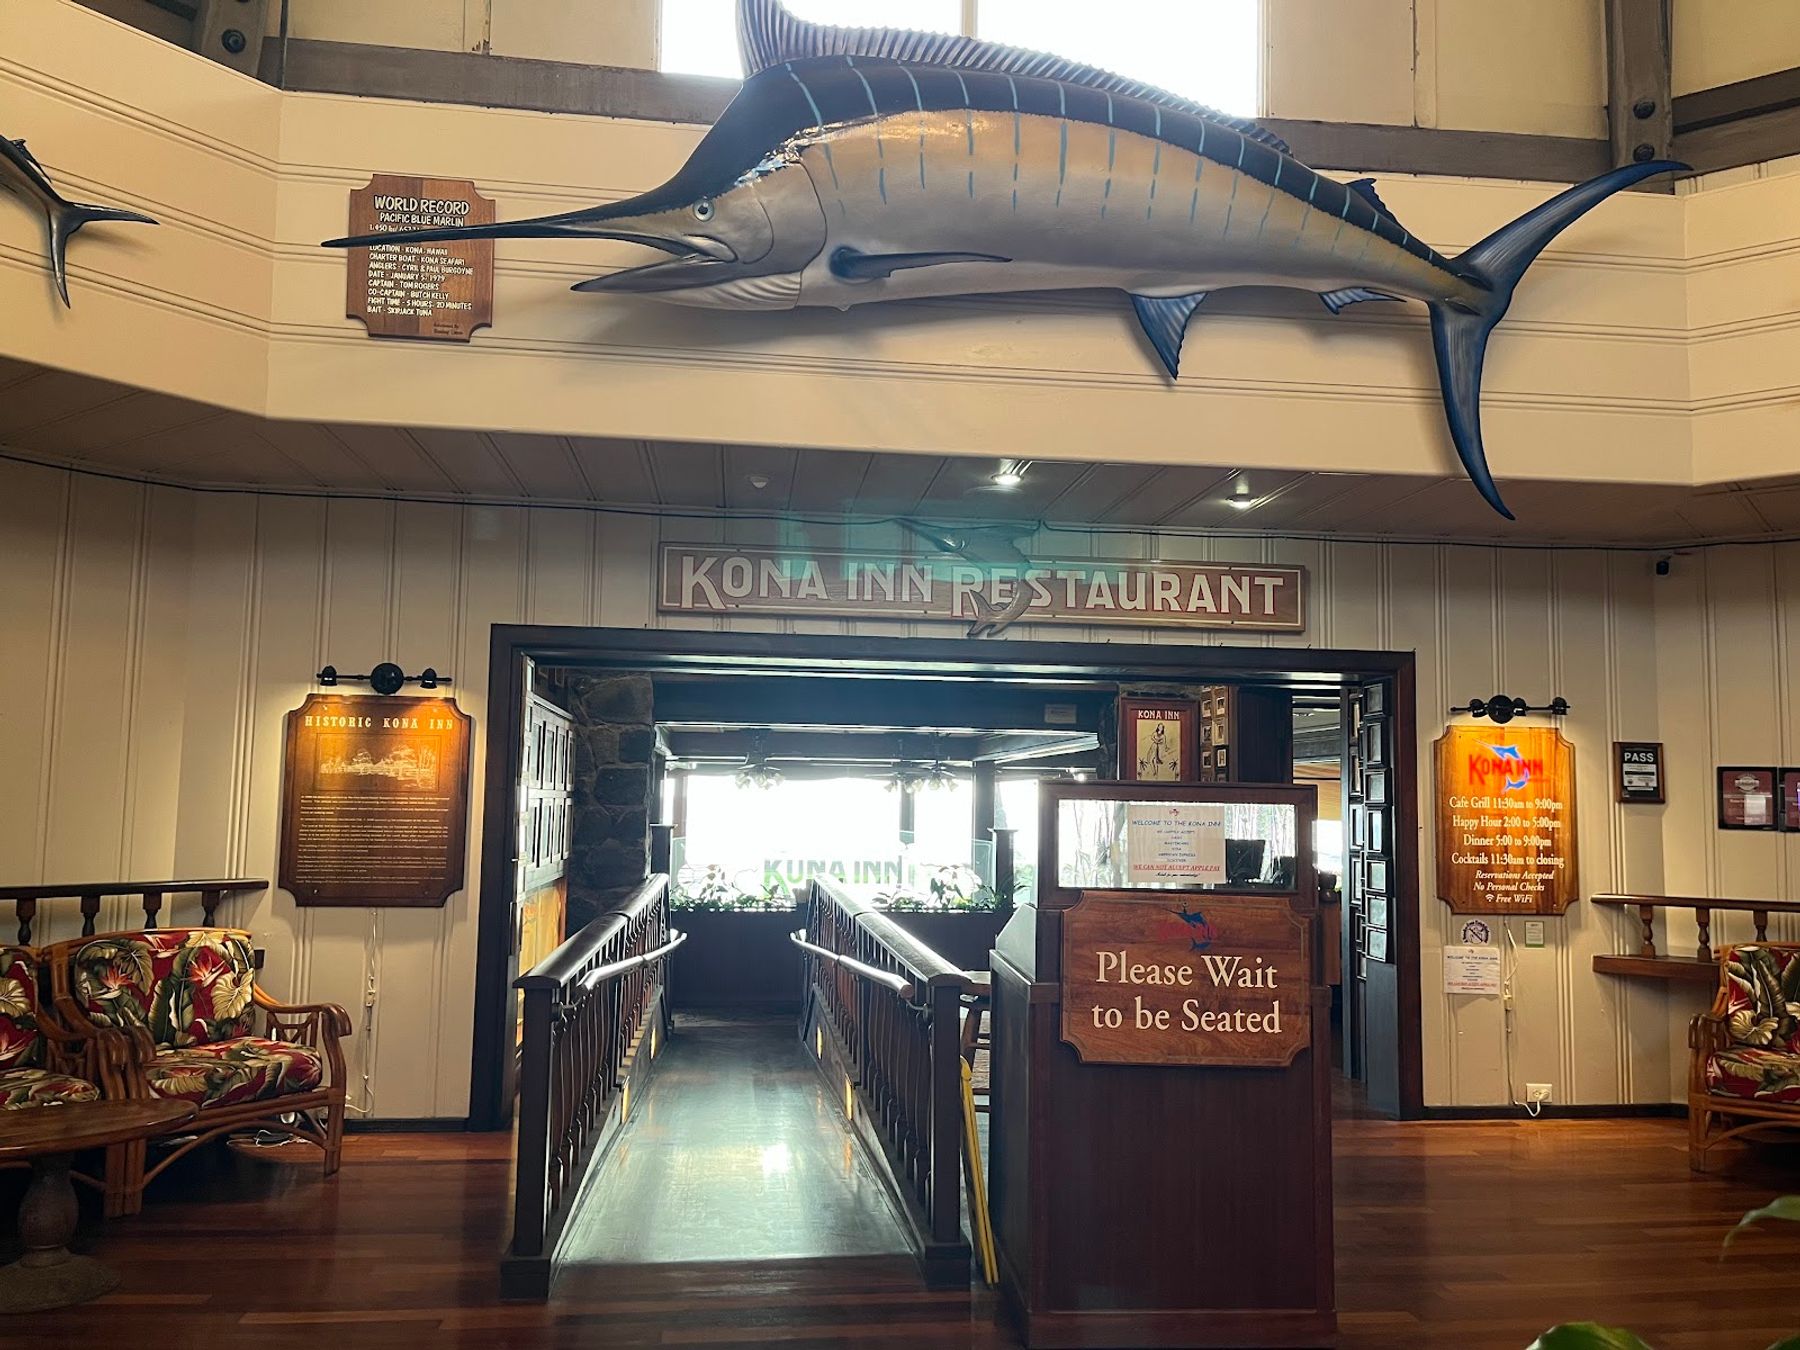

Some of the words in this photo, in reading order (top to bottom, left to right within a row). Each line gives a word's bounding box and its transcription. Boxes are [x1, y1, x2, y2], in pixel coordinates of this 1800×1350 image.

[374, 195, 418, 212] WORLD
[420, 199, 470, 215] RECORD
[380, 212, 410, 223] PACIFIC
[411, 214, 432, 225] BLUE
[433, 216, 464, 227] MARLIN
[369, 253, 398, 261] CHARTER
[398, 254, 416, 262] BOAT
[420, 256, 439, 264] KONA
[369, 261, 397, 270] ANGLERS
[368, 270, 385, 278] DATE
[390, 272, 420, 280] JANUARY
[368, 280, 394, 288] CAPTAIN
[399, 281, 414, 289] TOM
[414, 282, 440, 290] ROGERS
[368, 288, 406, 298] CO-CAPTAIN
[410, 290, 431, 299] BUTCH
[431, 292, 449, 300] KELLY
[367, 298, 385, 306] FIGHT
[386, 298, 400, 306] TIME
[436, 301, 445, 309] 20
[445, 302, 472, 310] MINUTES
[415, 308, 432, 316] TUNA
[681, 556, 837, 609] KONA
[846, 561, 934, 603] INN
[951, 565, 1286, 616] RESTAURANT
[1138, 710, 1161, 719] KONA
[1164, 711, 1179, 720] INN
[305, 715, 372, 727] HISTORIC
[383, 717, 419, 729] KONA
[429, 718, 453, 730] INN
[1624, 752, 1654, 763] PASS
[1469, 754, 1513, 785] KONA
[1516, 759, 1543, 776] INN
[1449, 796, 1469, 809] Cafe
[1470, 796, 1490, 809] Grill
[1493, 797, 1524, 809] 11:30am
[1525, 799, 1534, 809] to
[1534, 798, 1563, 813] 9:00pm
[1453, 815, 1479, 830] Happy
[1480, 815, 1502, 827] Hour
[1503, 816, 1521, 828] 2:00
[1522, 818, 1530, 828] to
[1532, 816, 1561, 831] 5:00pm
[1463, 834, 1494, 846] Dinner
[1495, 834, 1513, 847] 5:00
[1514, 837, 1522, 846] to
[1523, 835, 1552, 850] 9:00pm
[1451, 852, 1489, 865] Cocktails
[1490, 853, 1524, 865] 11:30am
[1526, 855, 1535, 865] to
[1536, 853, 1564, 869] closing
[854, 861, 902, 884] INN
[1475, 869, 1521, 880] Reservations
[1521, 870, 1555, 882] Accepted
[1473, 882, 1485, 891] No
[1486, 882, 1518, 891] Personal
[1519, 882, 1545, 891] Checks
[1495, 894, 1512, 903] Free
[1096, 950, 1193, 986] Please
[1200, 954, 1278, 989] Wait
[1092, 1004, 1123, 1029] to
[1135, 996, 1170, 1030] be
[1181, 999, 1283, 1034] Seated
